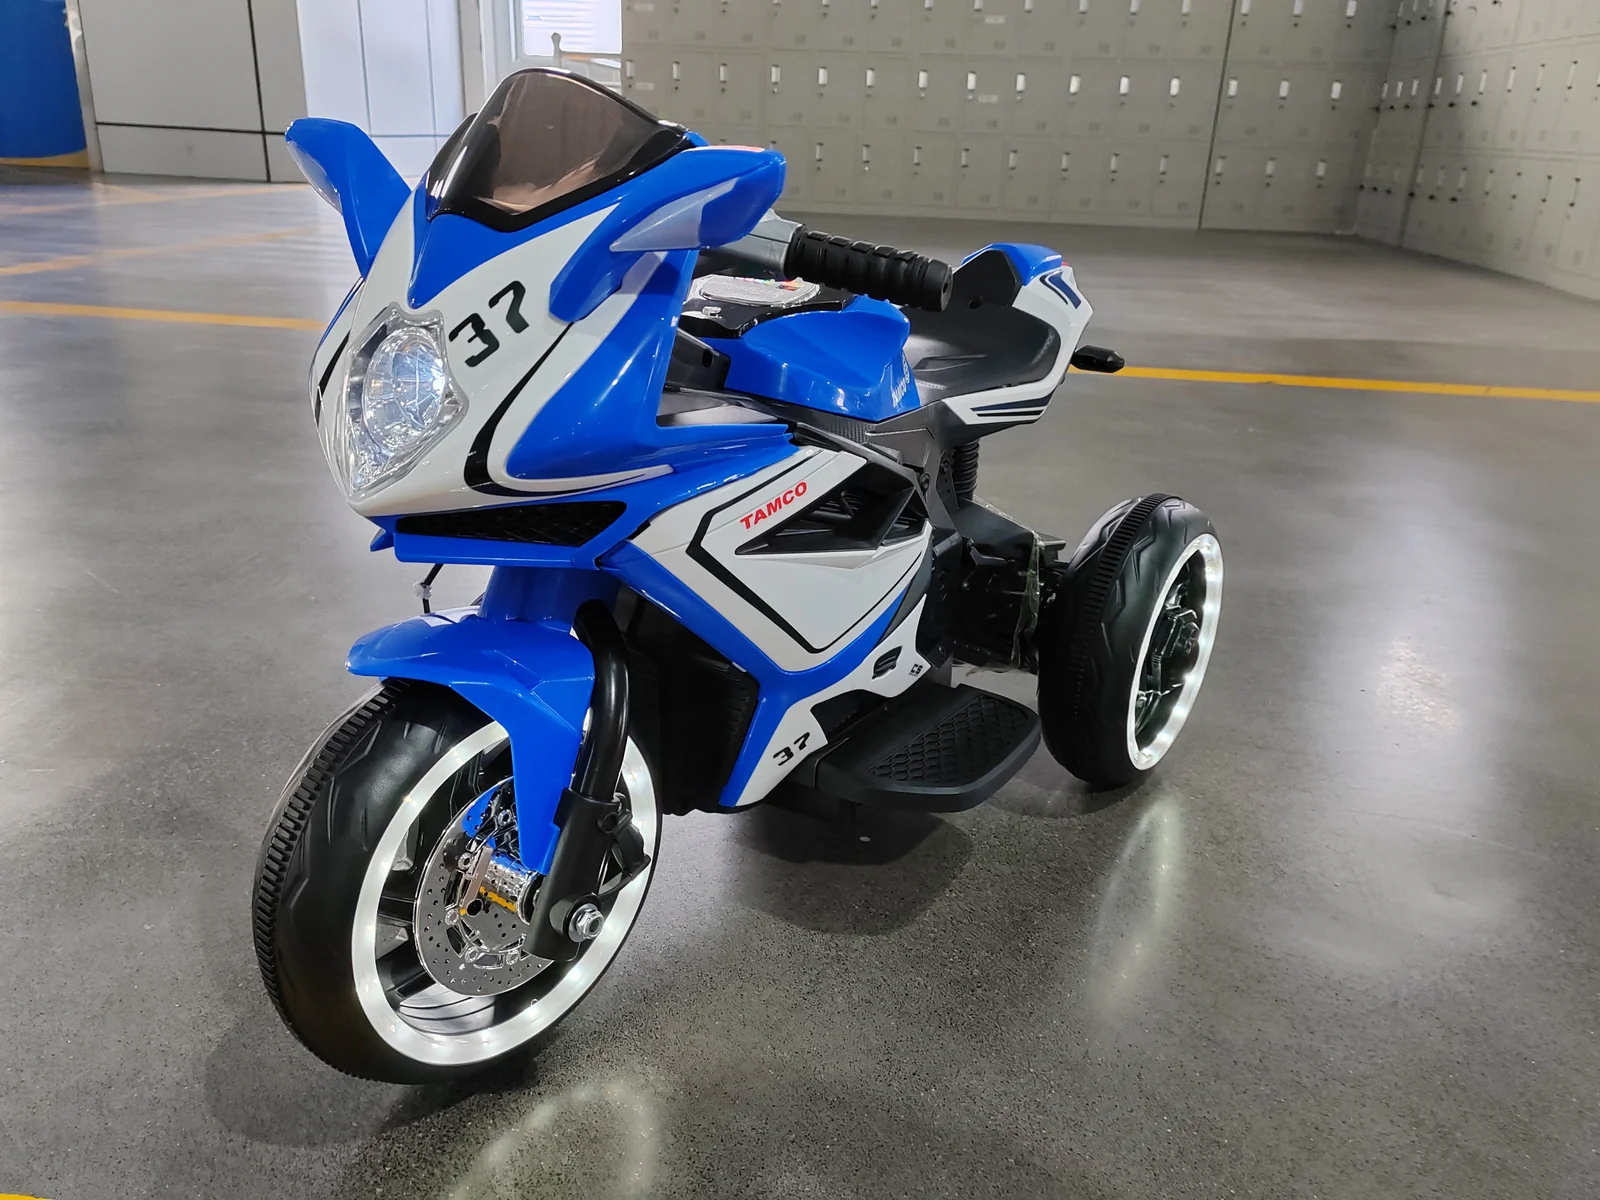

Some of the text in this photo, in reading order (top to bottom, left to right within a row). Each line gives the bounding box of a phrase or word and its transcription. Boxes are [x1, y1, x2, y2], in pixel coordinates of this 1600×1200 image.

[449, 280, 529, 367] 37
[740, 481, 807, 529] TAMCO
[773, 732, 810, 766] 37
